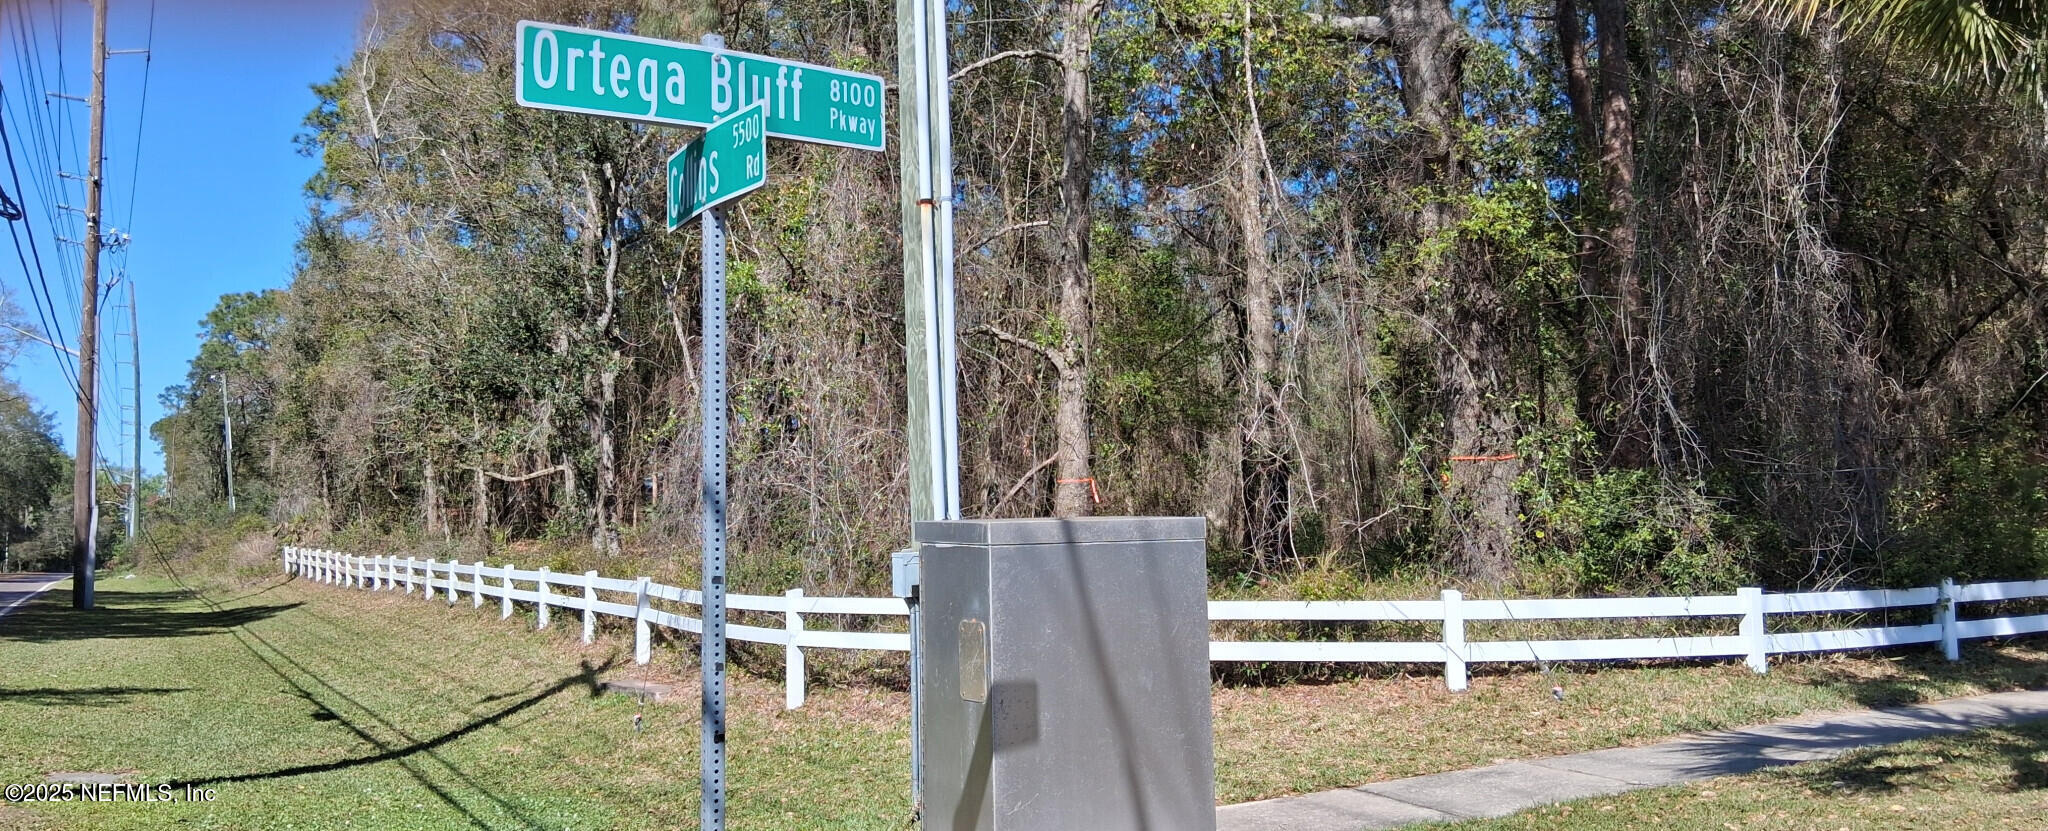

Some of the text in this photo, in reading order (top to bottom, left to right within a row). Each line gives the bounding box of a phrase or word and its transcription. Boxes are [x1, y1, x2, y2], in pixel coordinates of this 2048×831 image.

[533, 29, 803, 122] Ortega Bluff
[830, 79, 875, 108] 8100
[732, 114, 760, 149] 5500
[830, 107, 876, 140] Pkway
[746, 152, 760, 180] Rd
[670, 150, 719, 219] Collins
